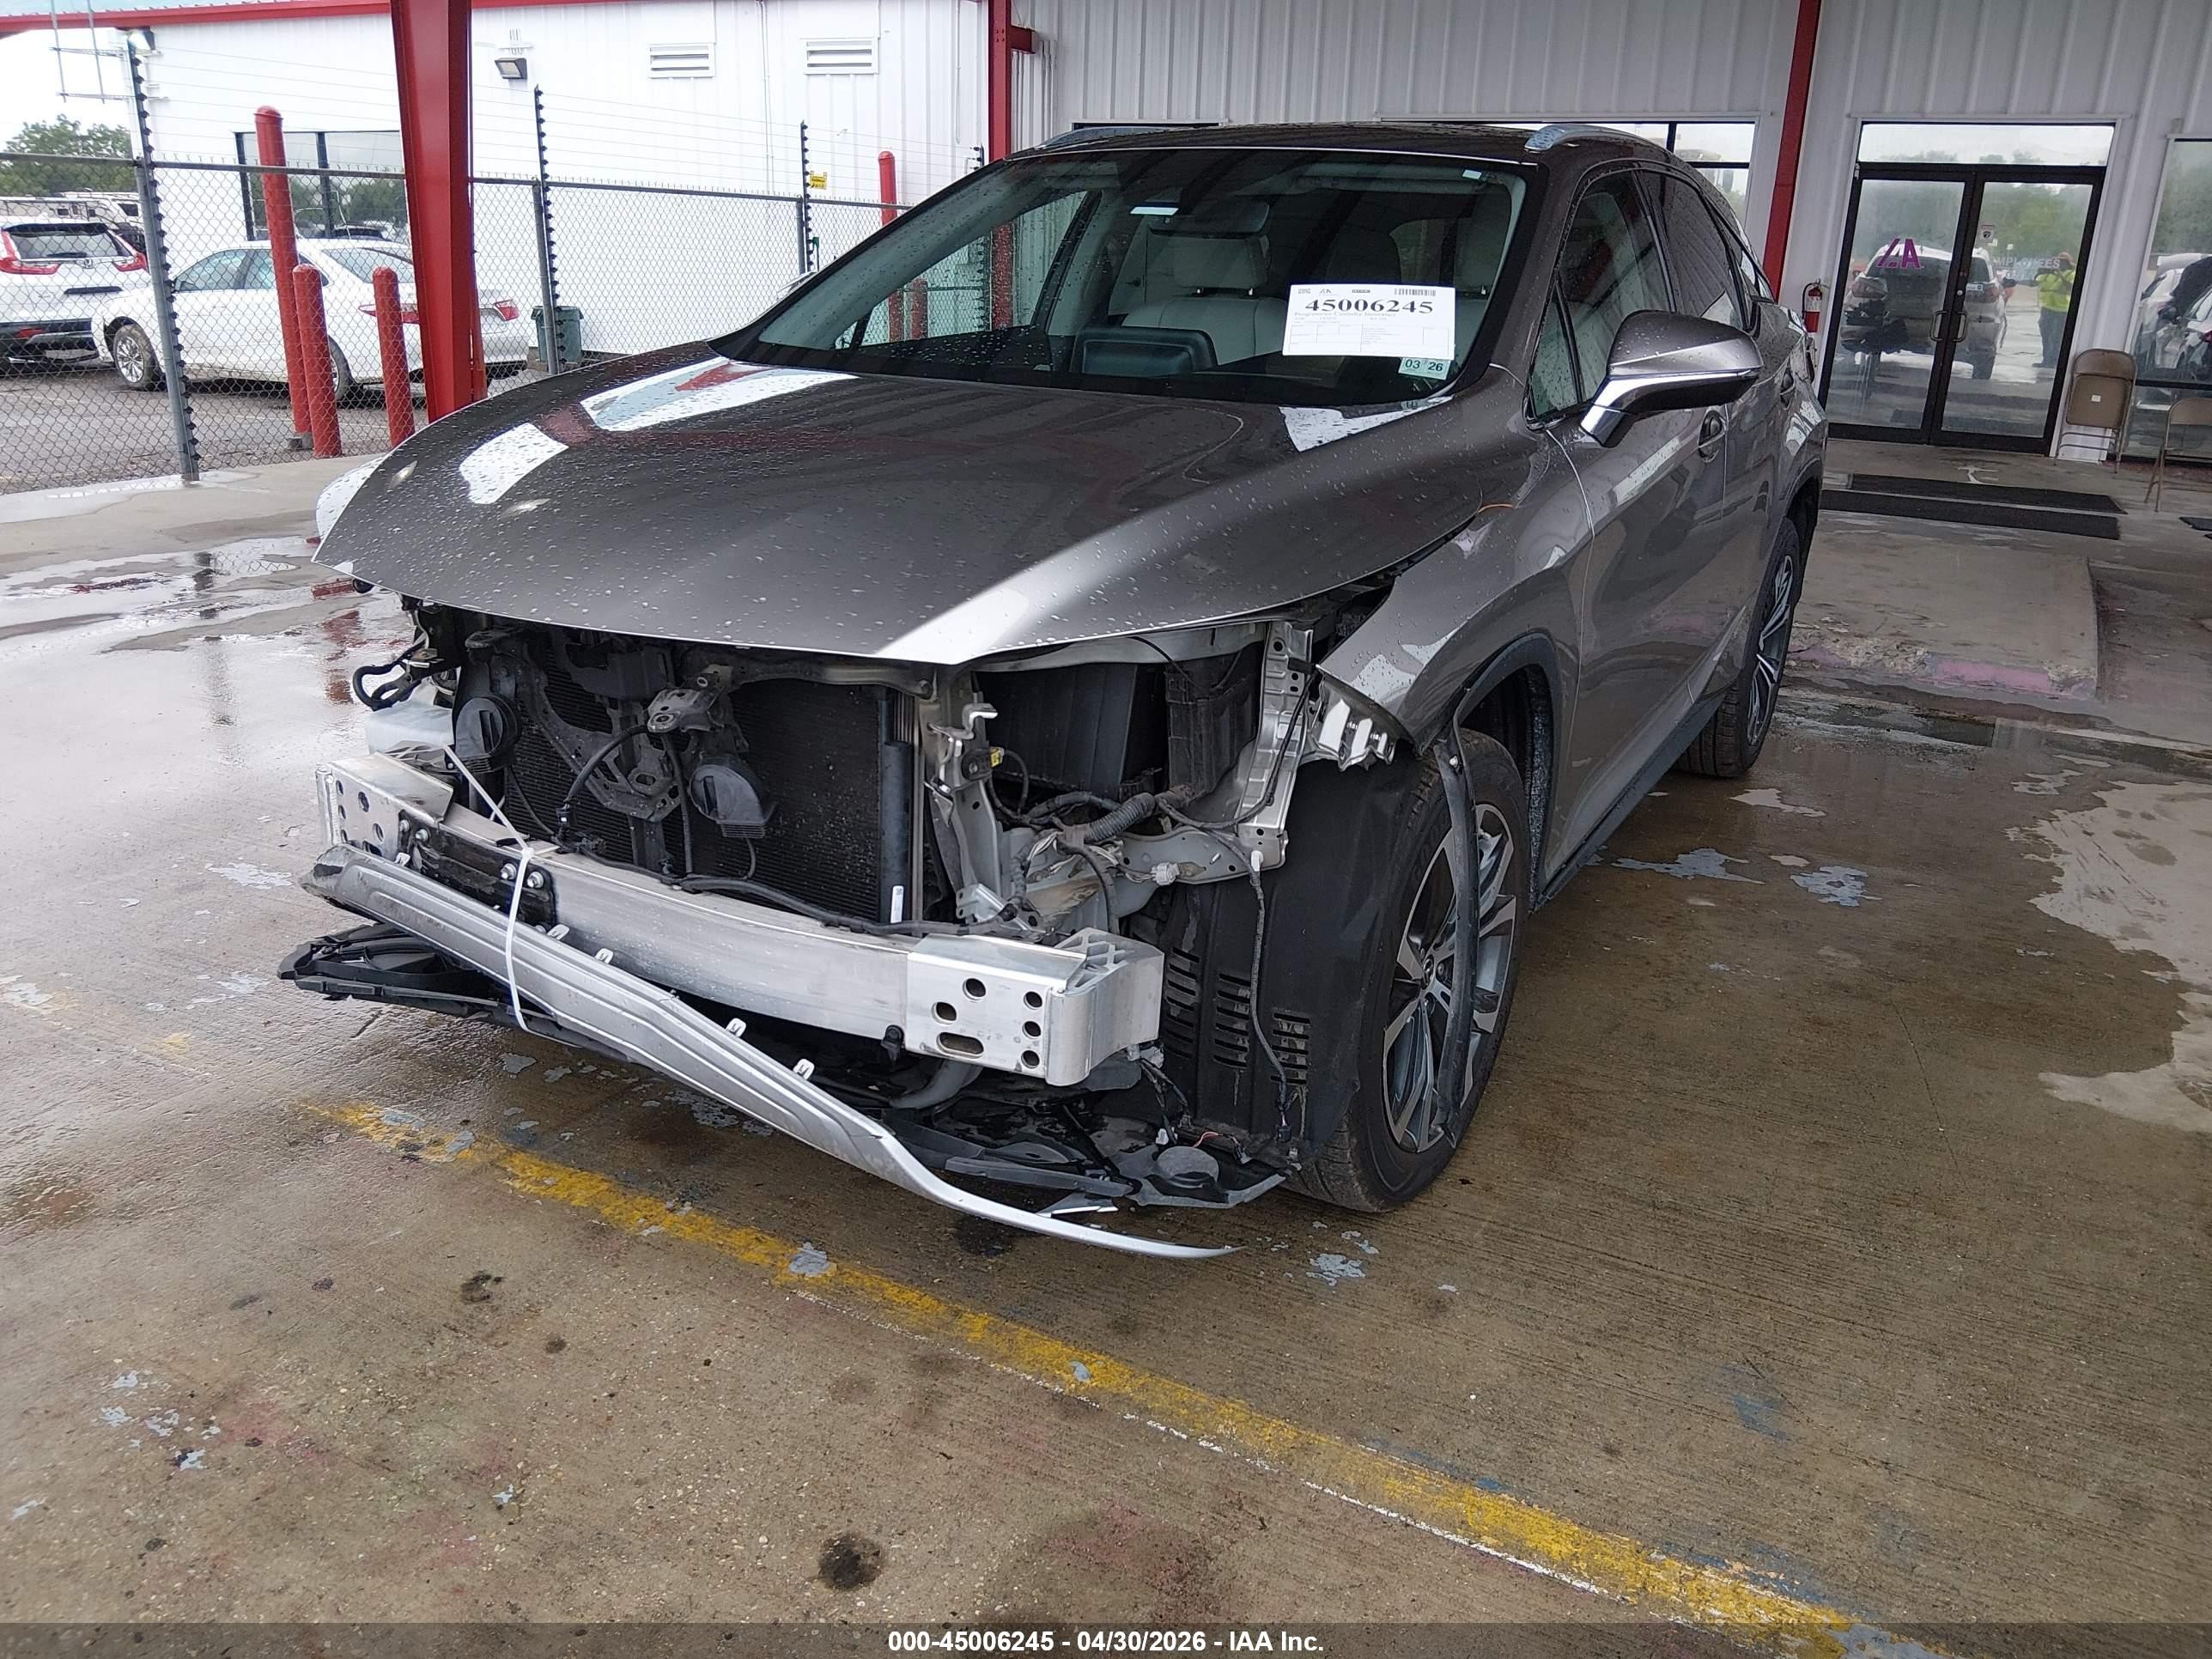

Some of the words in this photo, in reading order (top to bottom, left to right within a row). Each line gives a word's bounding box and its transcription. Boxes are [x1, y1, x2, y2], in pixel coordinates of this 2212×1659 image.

[1304, 298, 1434, 314] 45006245
[1405, 358, 1421, 369] 03
[1427, 362, 1444, 372] 26
